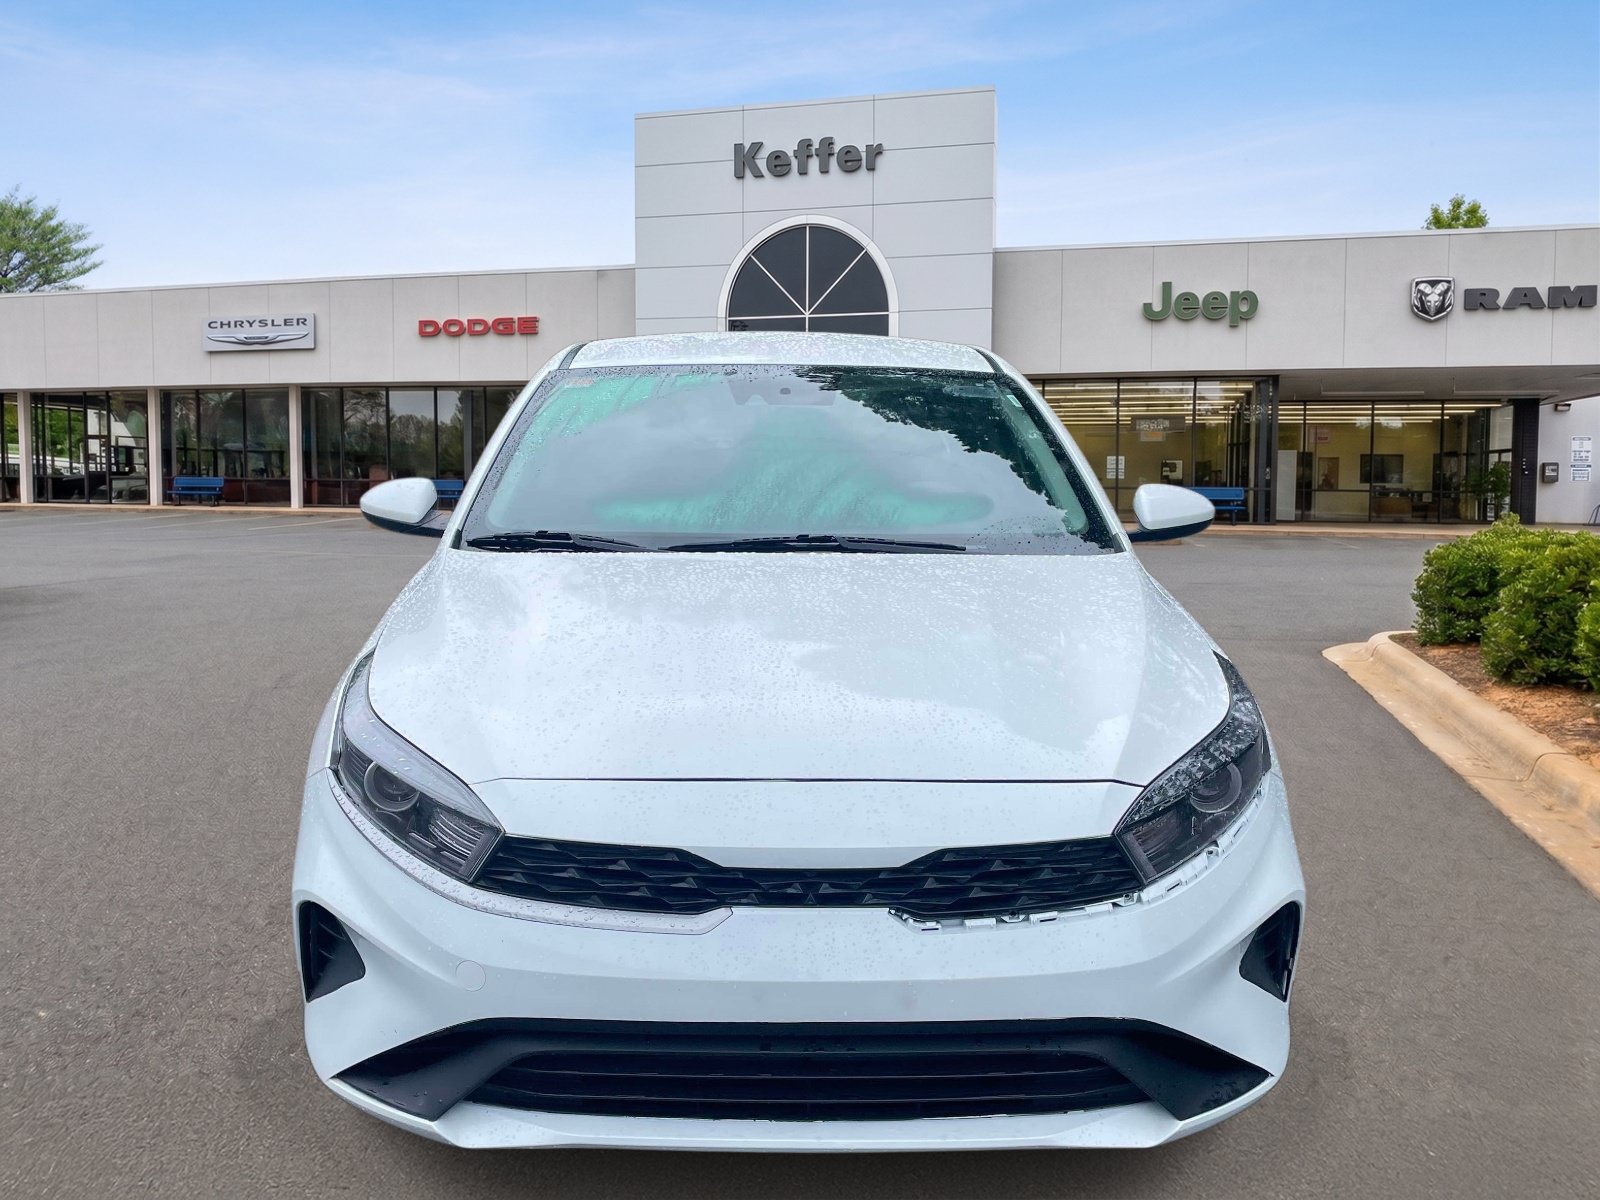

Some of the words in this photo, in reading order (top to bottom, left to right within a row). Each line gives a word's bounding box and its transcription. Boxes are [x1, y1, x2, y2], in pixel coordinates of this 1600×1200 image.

[733, 136, 884, 179] Keffer
[1142, 281, 1259, 328] Jeep
[1463, 285, 1598, 310] RAM
[207, 317, 308, 329] CHRYSLER
[418, 316, 539, 337] DODGE
